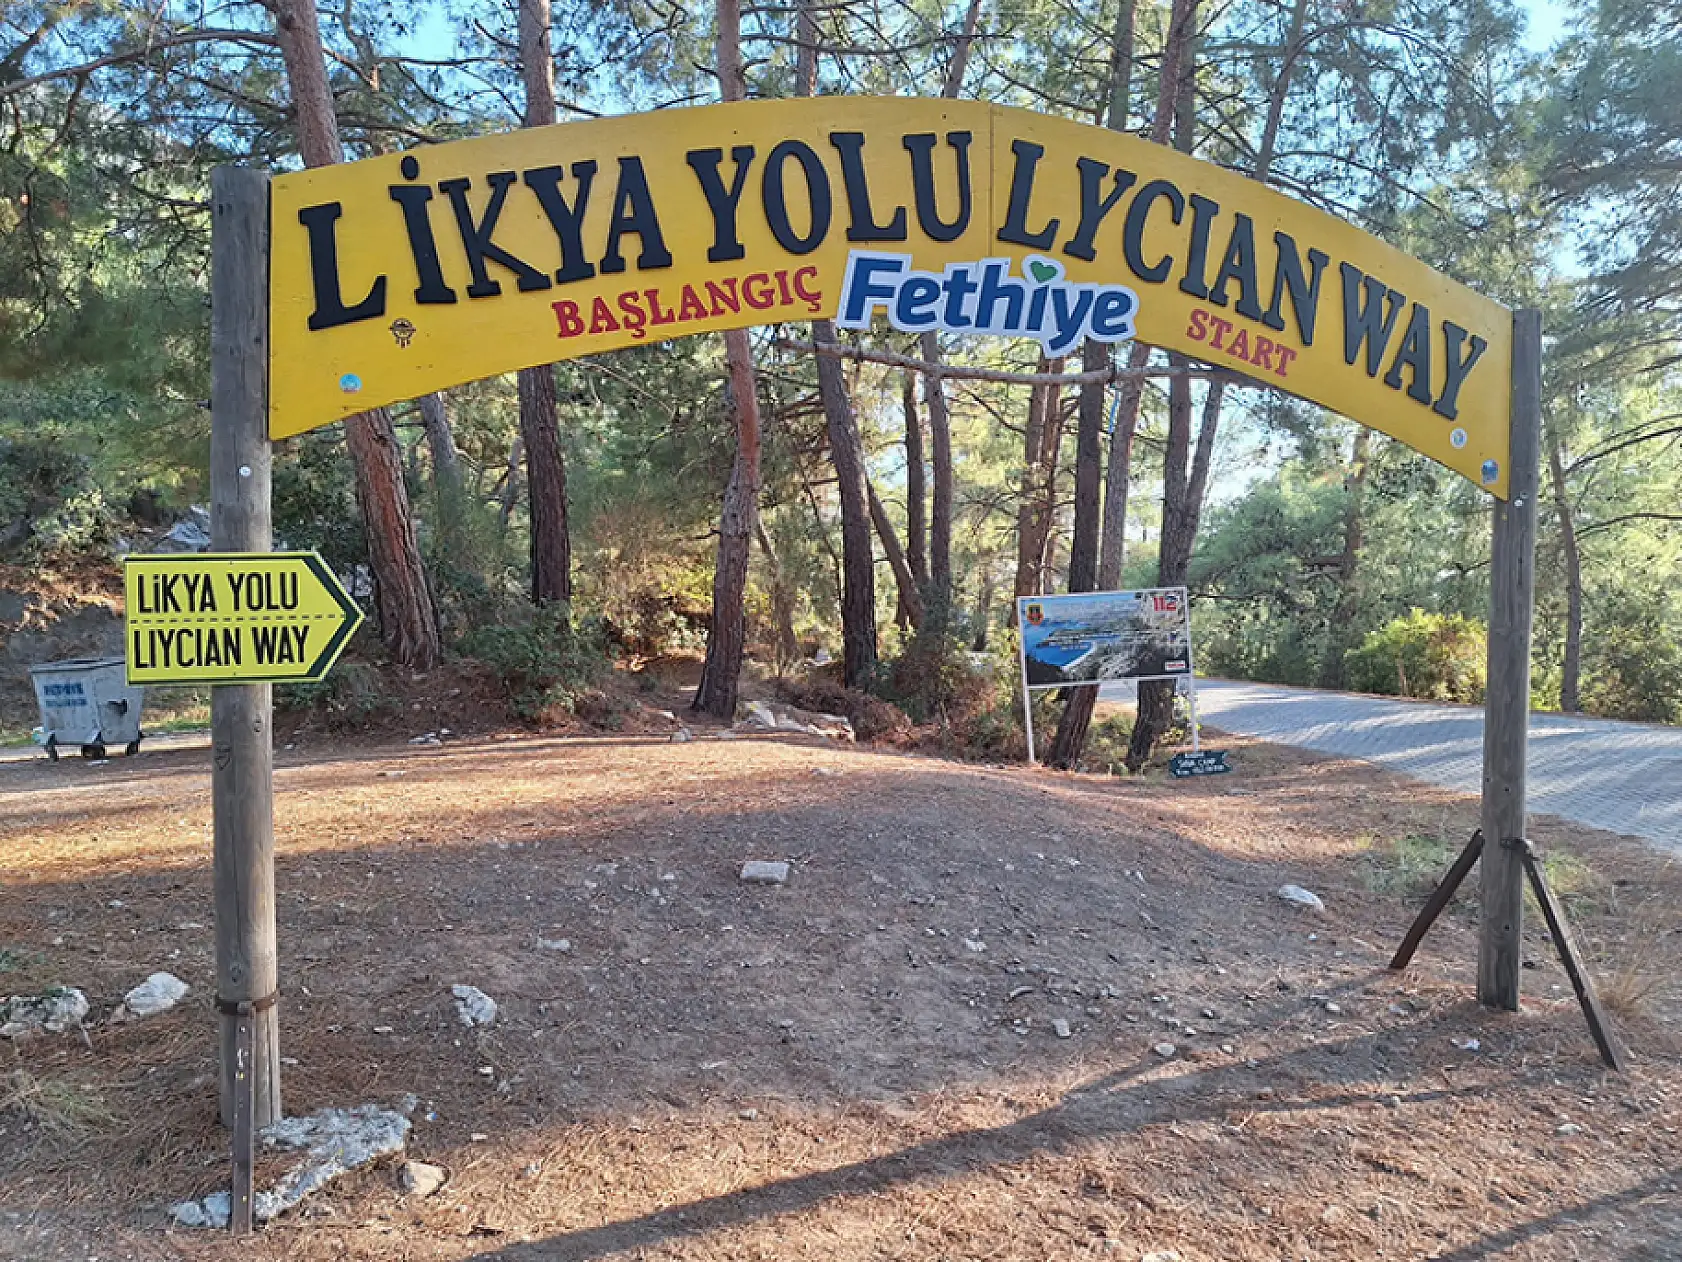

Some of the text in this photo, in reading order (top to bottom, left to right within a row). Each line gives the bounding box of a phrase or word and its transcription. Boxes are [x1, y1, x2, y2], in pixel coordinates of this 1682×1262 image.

[299, 131, 1488, 421] LİKYA YOLU LYCIAN WAY
[551, 266, 823, 338] BAŞLANGIÇ
[843, 257, 1132, 346] Fethiye
[1186, 309, 1297, 377] START
[227, 571, 299, 610] YOLU
[134, 625, 310, 668] LIYCIAN WAY
